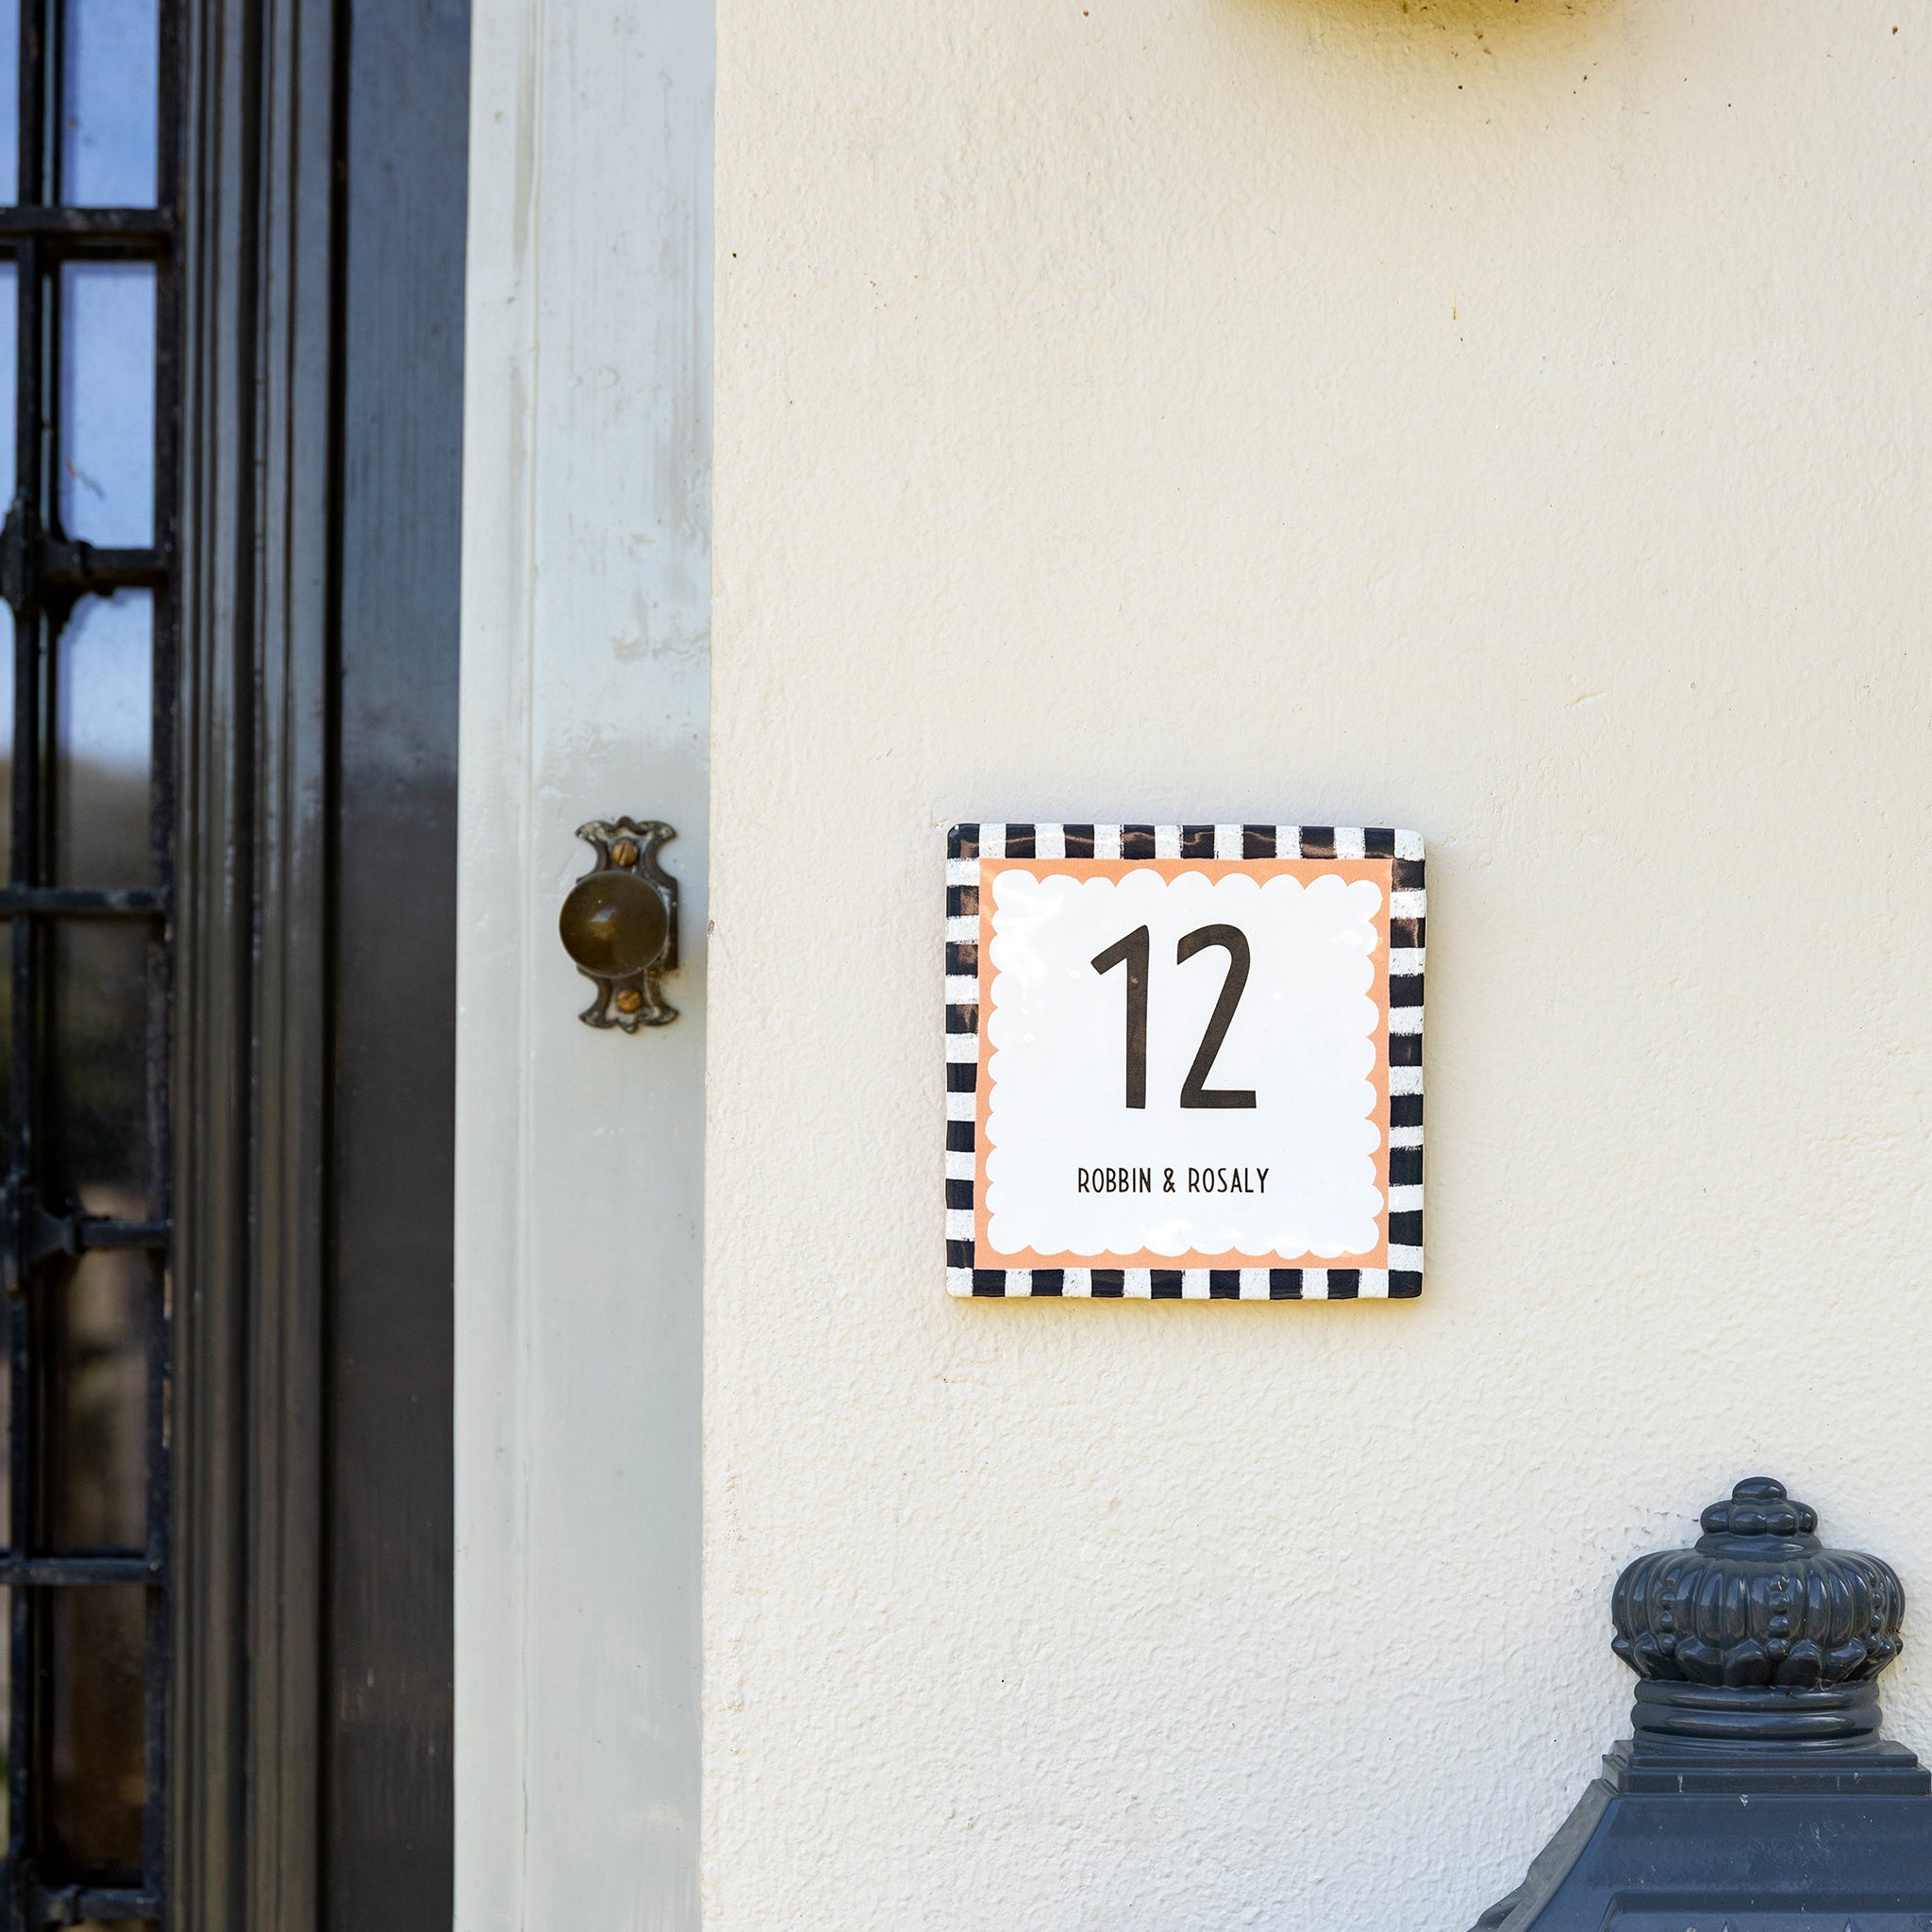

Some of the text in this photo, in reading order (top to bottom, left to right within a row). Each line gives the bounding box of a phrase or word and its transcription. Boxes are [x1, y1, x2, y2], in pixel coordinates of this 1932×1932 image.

[1090, 924, 1257, 1109] 12
[1077, 1167, 1270, 1193] ROBBIN & ROSALY
